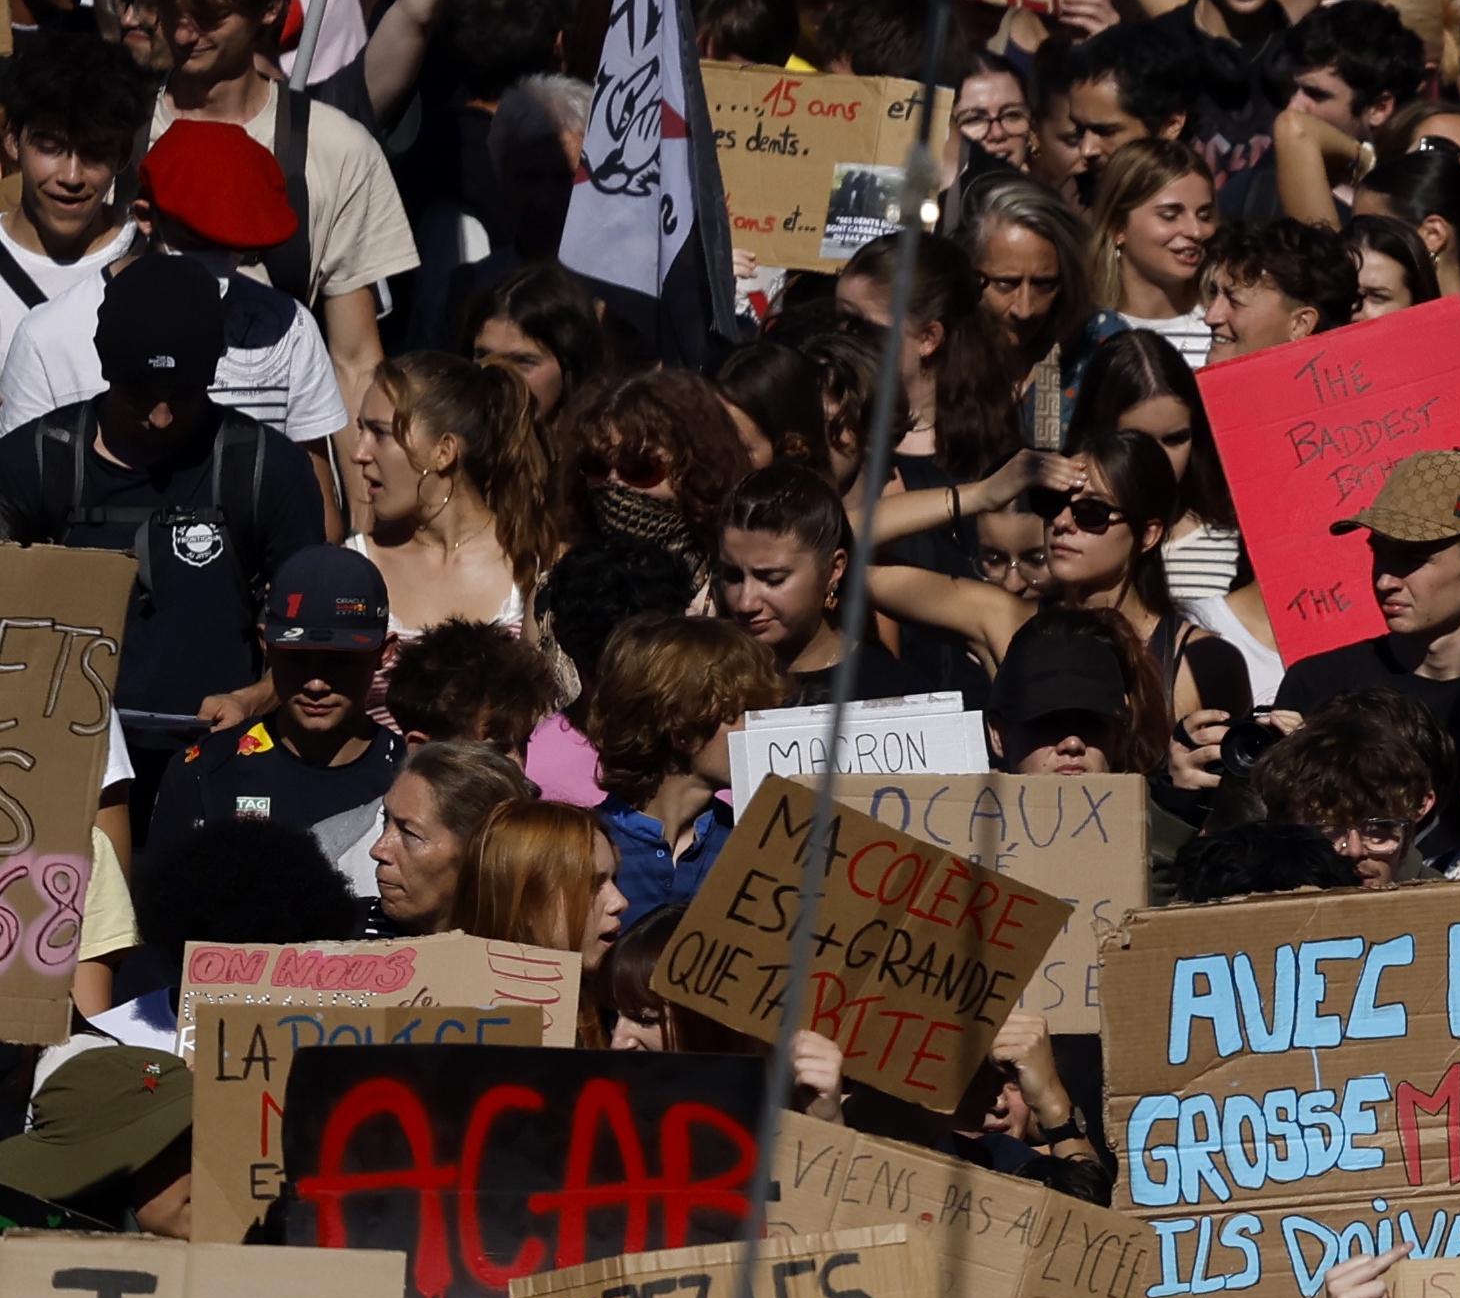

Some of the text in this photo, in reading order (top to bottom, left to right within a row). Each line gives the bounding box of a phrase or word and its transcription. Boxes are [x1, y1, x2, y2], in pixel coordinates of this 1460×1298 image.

[1291, 350, 1374, 408] THE
[1283, 395, 1438, 473] BADDEST
[1287, 579, 1354, 622] THE
[236, 797, 266, 810] TAG
[847, 839, 1040, 950] COLÈRE
[271, 946, 418, 993] NOUS
[845, 918, 1016, 1027] GRANDE
[1166, 933, 1416, 1067] AVEC
[297, 1074, 772, 1288] ACAB
[1125, 1072, 1395, 1208] GROSSE
